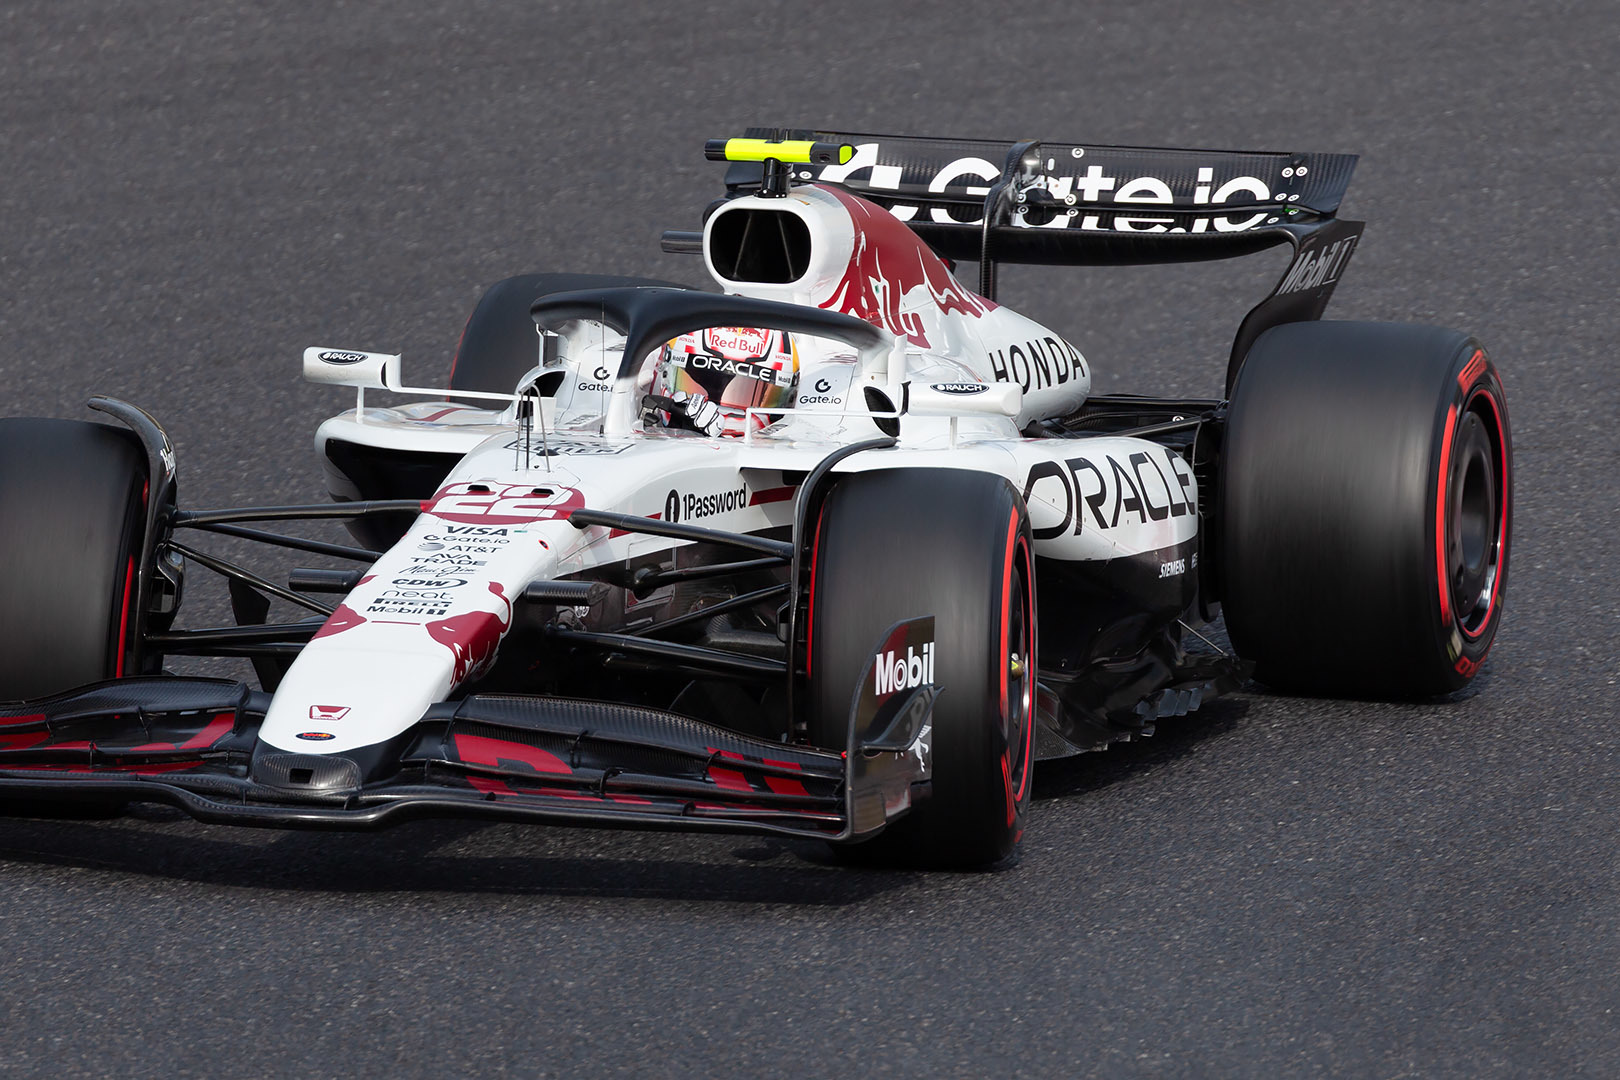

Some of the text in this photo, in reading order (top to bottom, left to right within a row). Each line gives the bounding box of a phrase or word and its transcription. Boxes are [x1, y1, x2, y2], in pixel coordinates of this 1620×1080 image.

[1275, 241, 1341, 296] Mobil
[711, 335, 764, 355] Red Bull
[330, 352, 363, 361] RAUCH
[692, 356, 772, 382] ORACLE
[988, 336, 1086, 395] HONDA
[578, 382, 614, 392] Gate.i
[800, 395, 842, 405] Gate.io
[430, 481, 574, 519] 22
[682, 482, 747, 521] 1Password
[1023, 449, 1196, 540] ORACLE
[445, 525, 509, 537] VISA
[442, 535, 511, 545] Gate.io
[447, 545, 503, 554] AT&T
[411, 557, 488, 566] TRADE
[1159, 558, 1185, 579] SIEMENS
[391, 578, 452, 588] CDW
[366, 605, 424, 615] Mobil
[875, 642, 935, 695] Mobil
